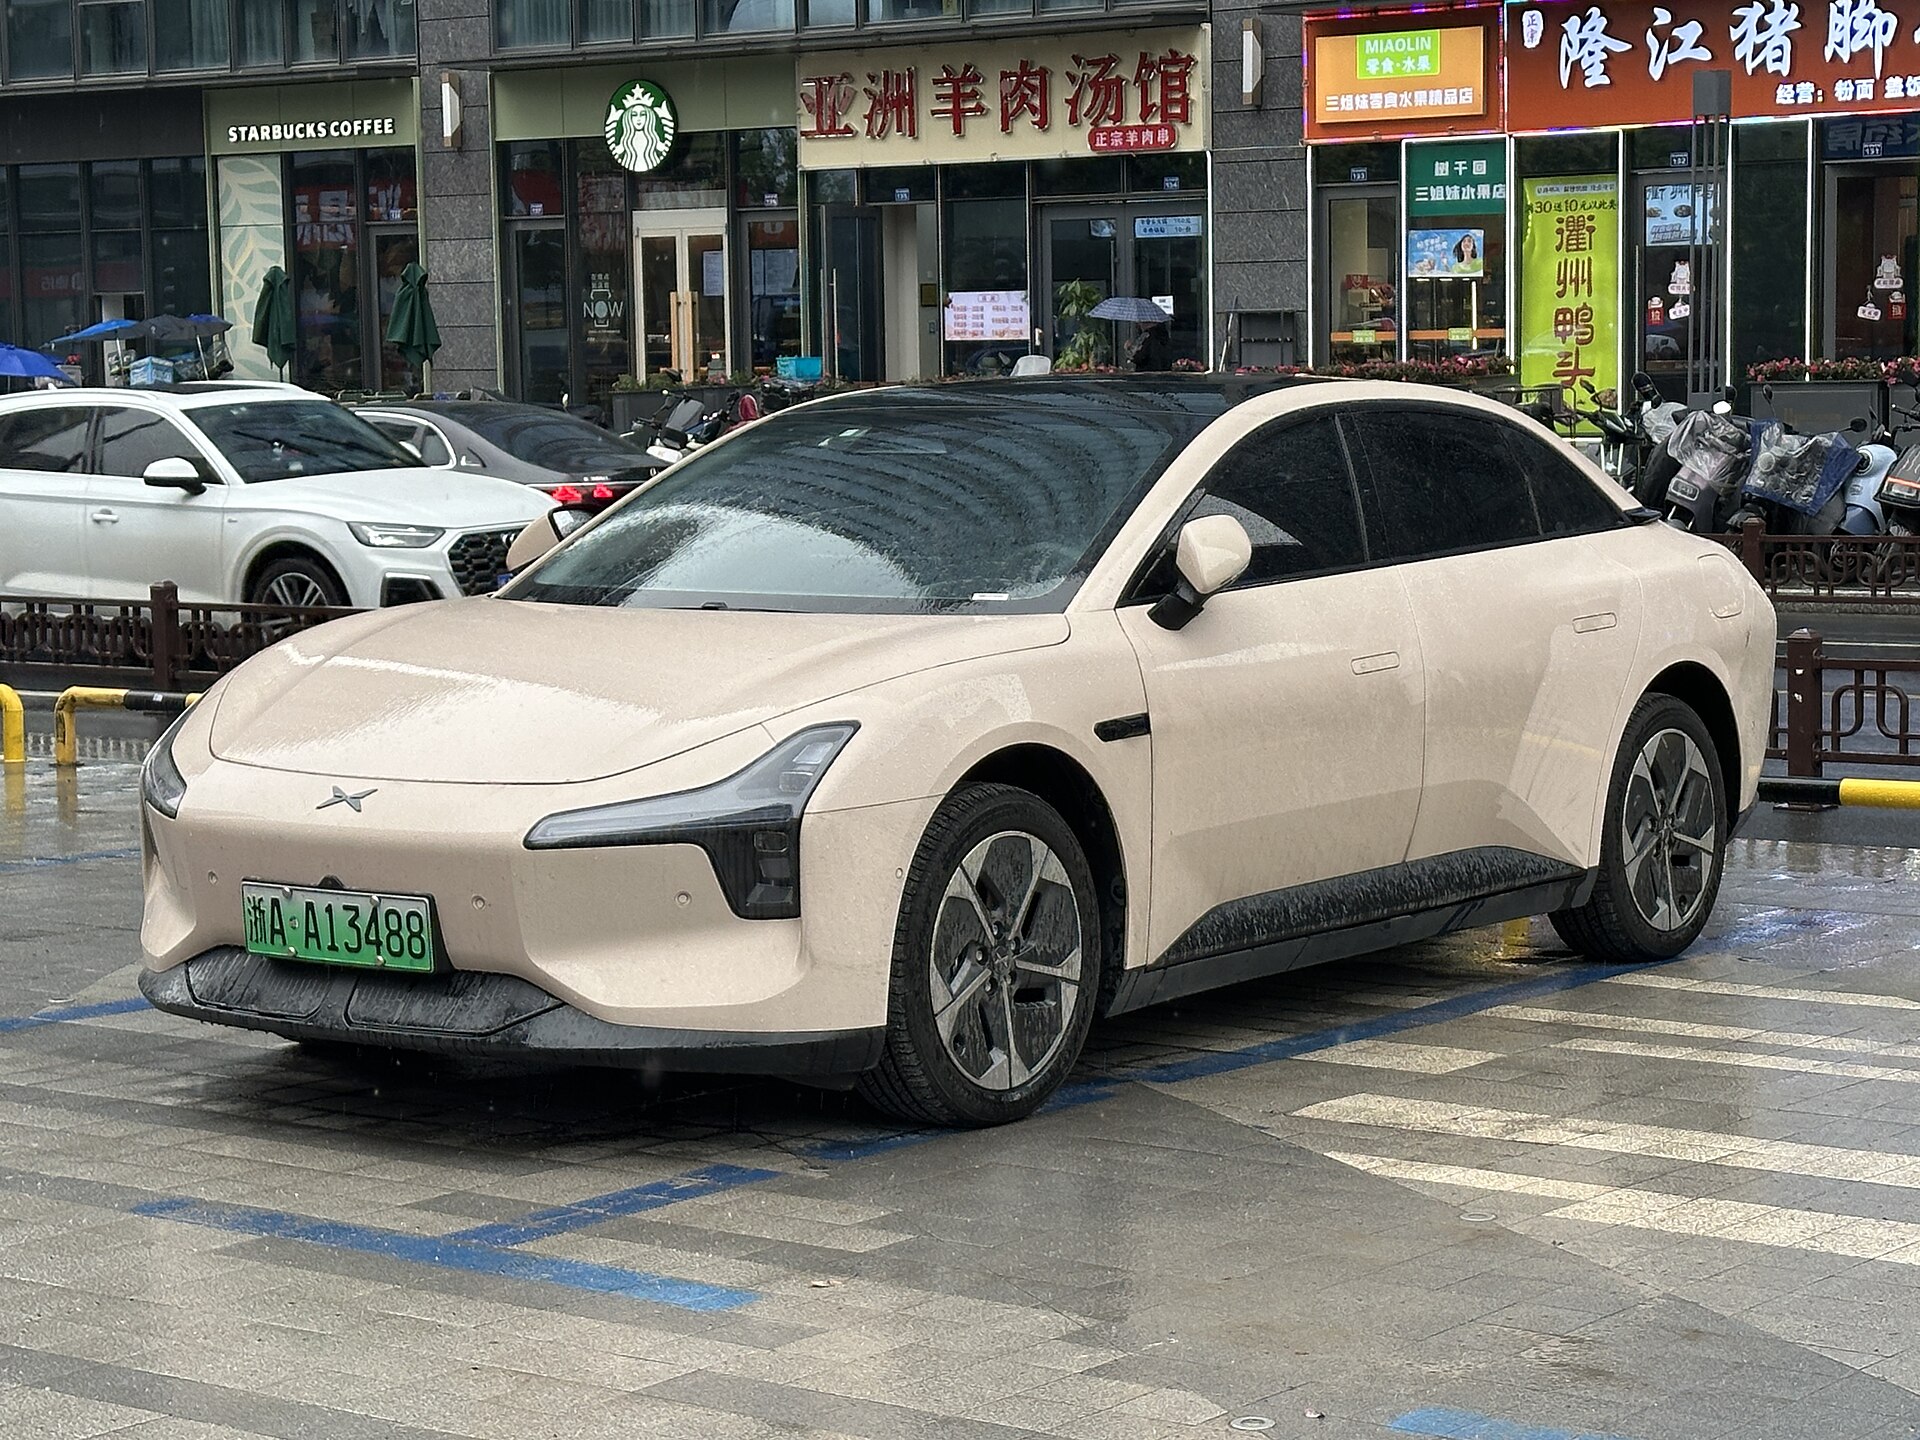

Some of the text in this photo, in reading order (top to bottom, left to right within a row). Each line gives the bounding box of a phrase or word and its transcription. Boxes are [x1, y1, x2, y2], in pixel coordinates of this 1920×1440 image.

[1365, 36, 1431, 54] MIAOLIN
[1560, 1, 1920, 89] 隆江猪脚
[800, 48, 1198, 139] 亚洲羊肉汤馆
[1325, 87, 1474, 112] 三姐妹零食水果精品店
[1834, 79, 1875, 101] 粉面
[228, 117, 394, 143] STARBUCKS COFFEE
[1095, 127, 1169, 147] 正宗羊肉串
[1415, 183, 1506, 201] 三姐妹水果店
[583, 300, 623, 318] NOW
[1552, 214, 1597, 389] 衢州鸭头
